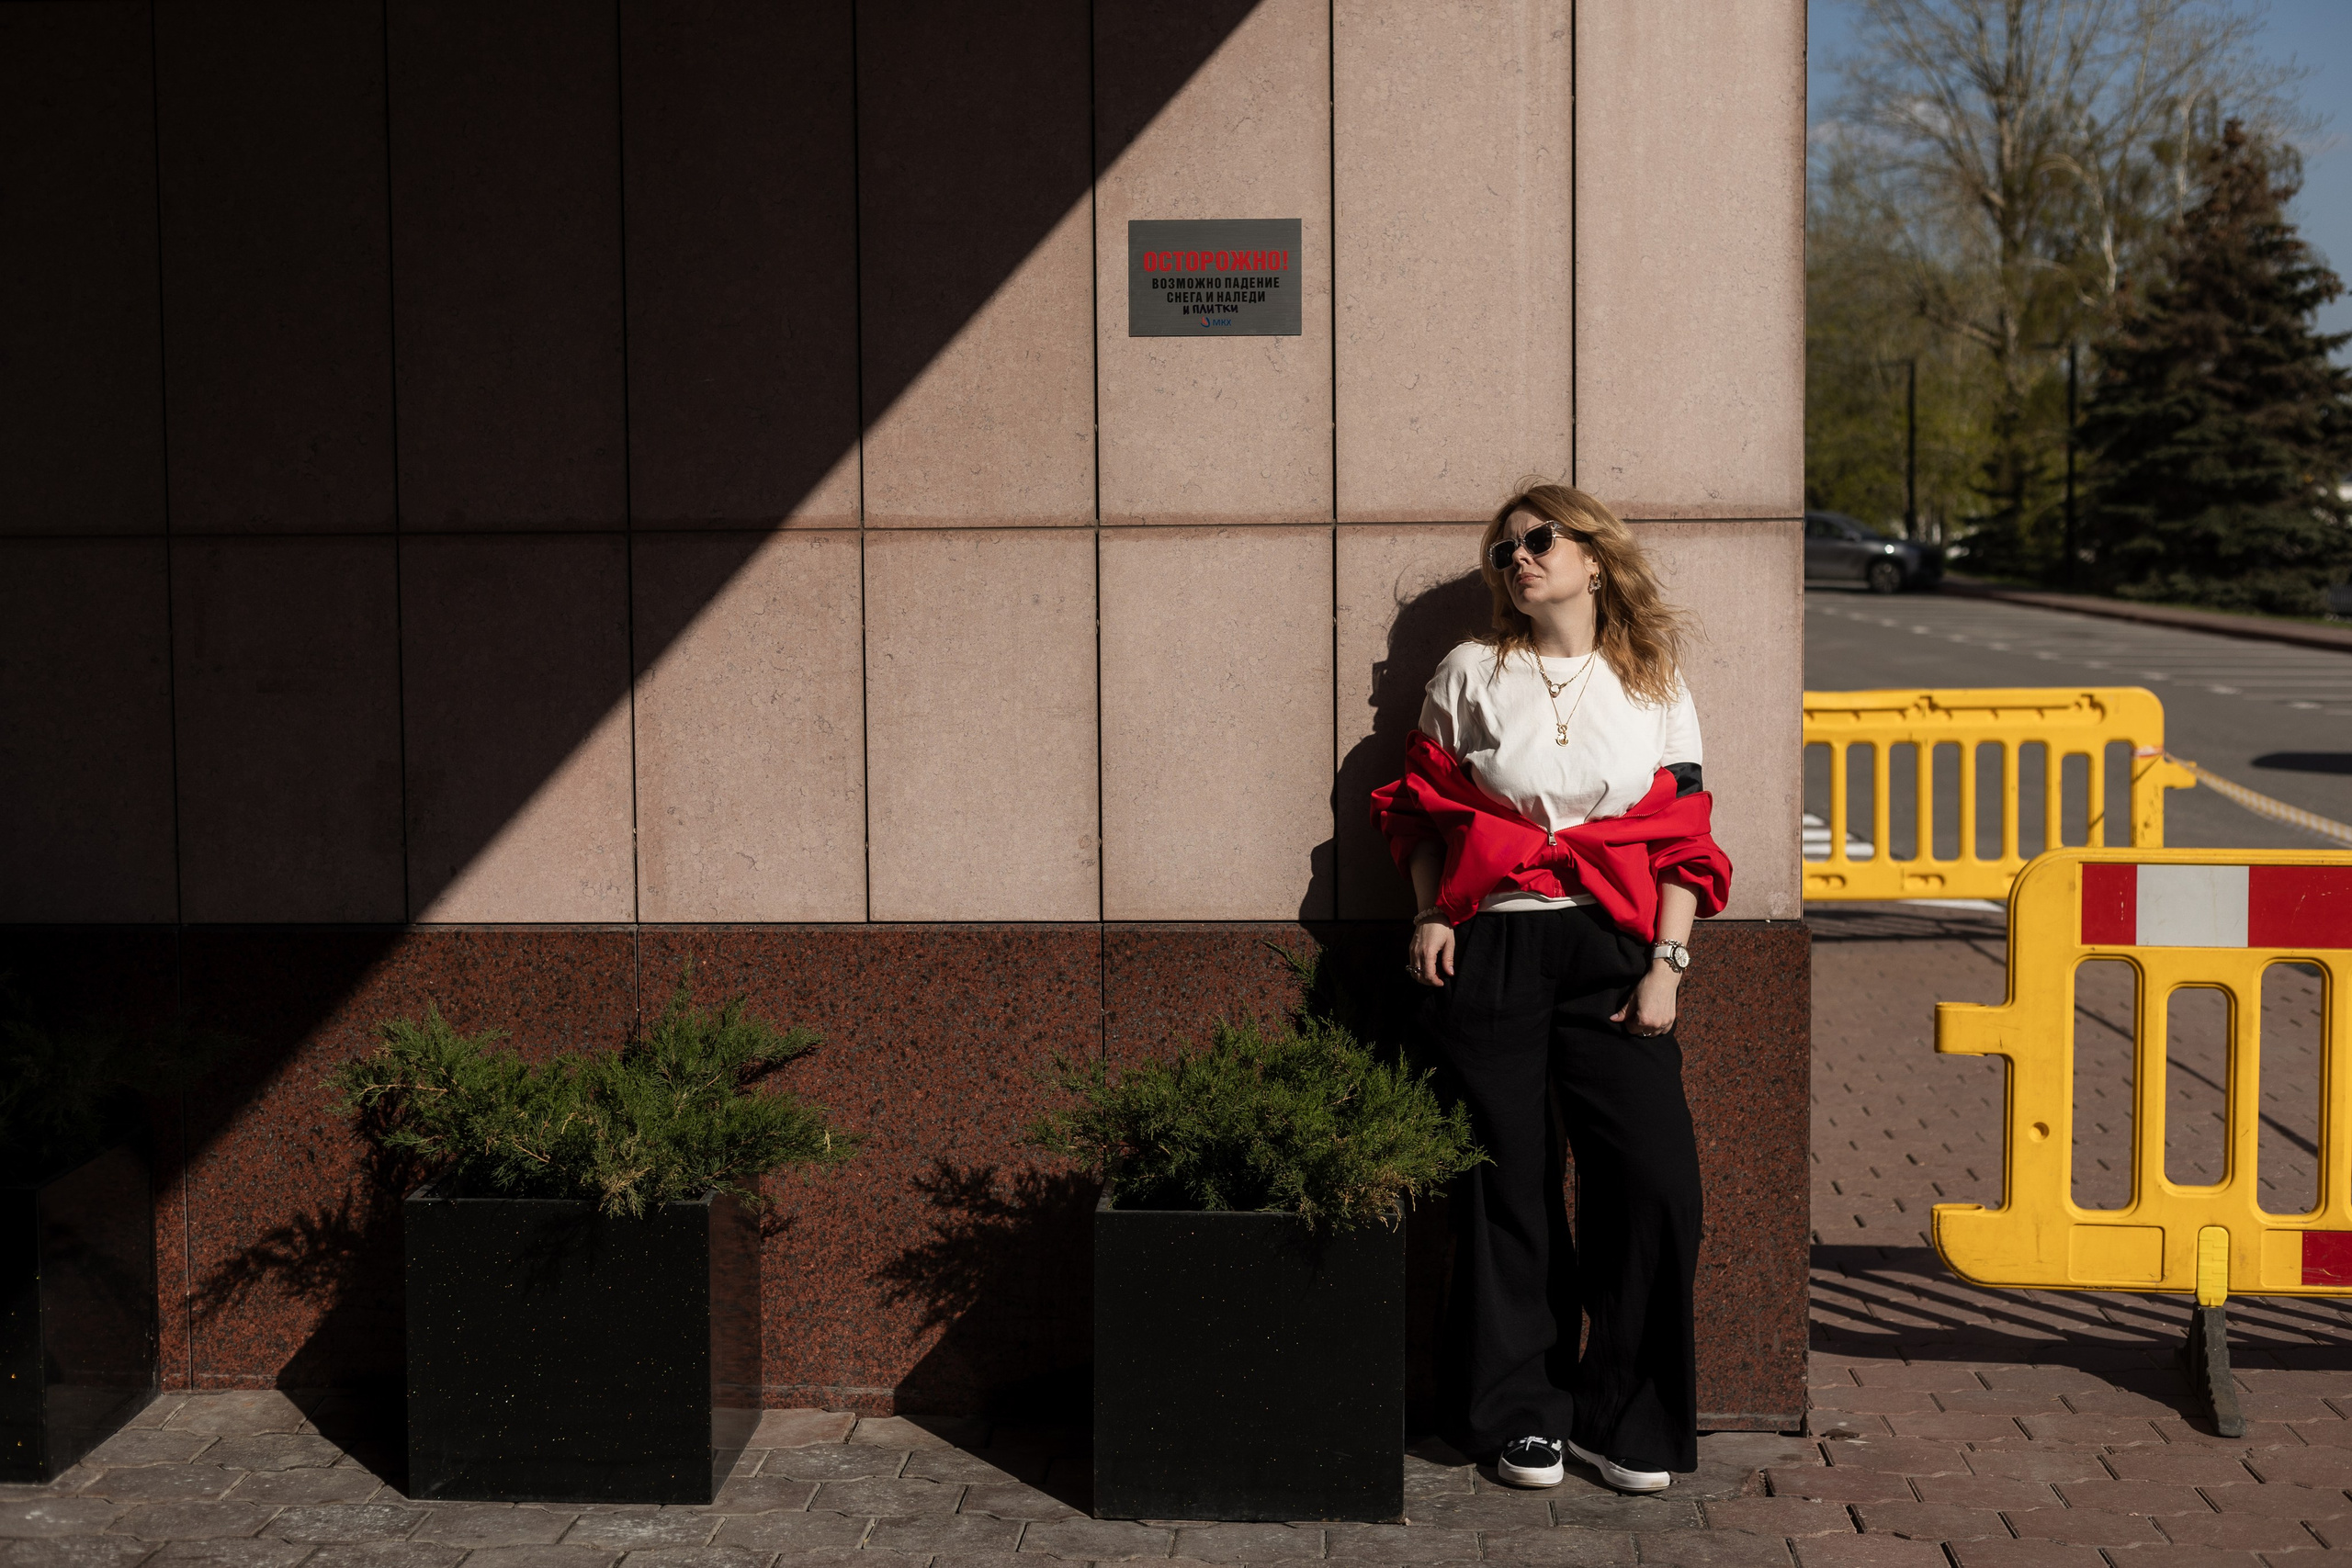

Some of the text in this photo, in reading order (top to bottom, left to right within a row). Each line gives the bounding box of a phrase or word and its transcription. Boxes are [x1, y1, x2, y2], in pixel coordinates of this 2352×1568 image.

[1143, 250, 1288, 272] ОСТОРОЖНО!
[1152, 276, 1280, 289] ВОЗМОЖНО ПАДЕНИЕ
[1167, 290, 1266, 303] СНЕГА И НАЛЕДИ
[1193, 303, 1238, 314] ПЛИТКИ
